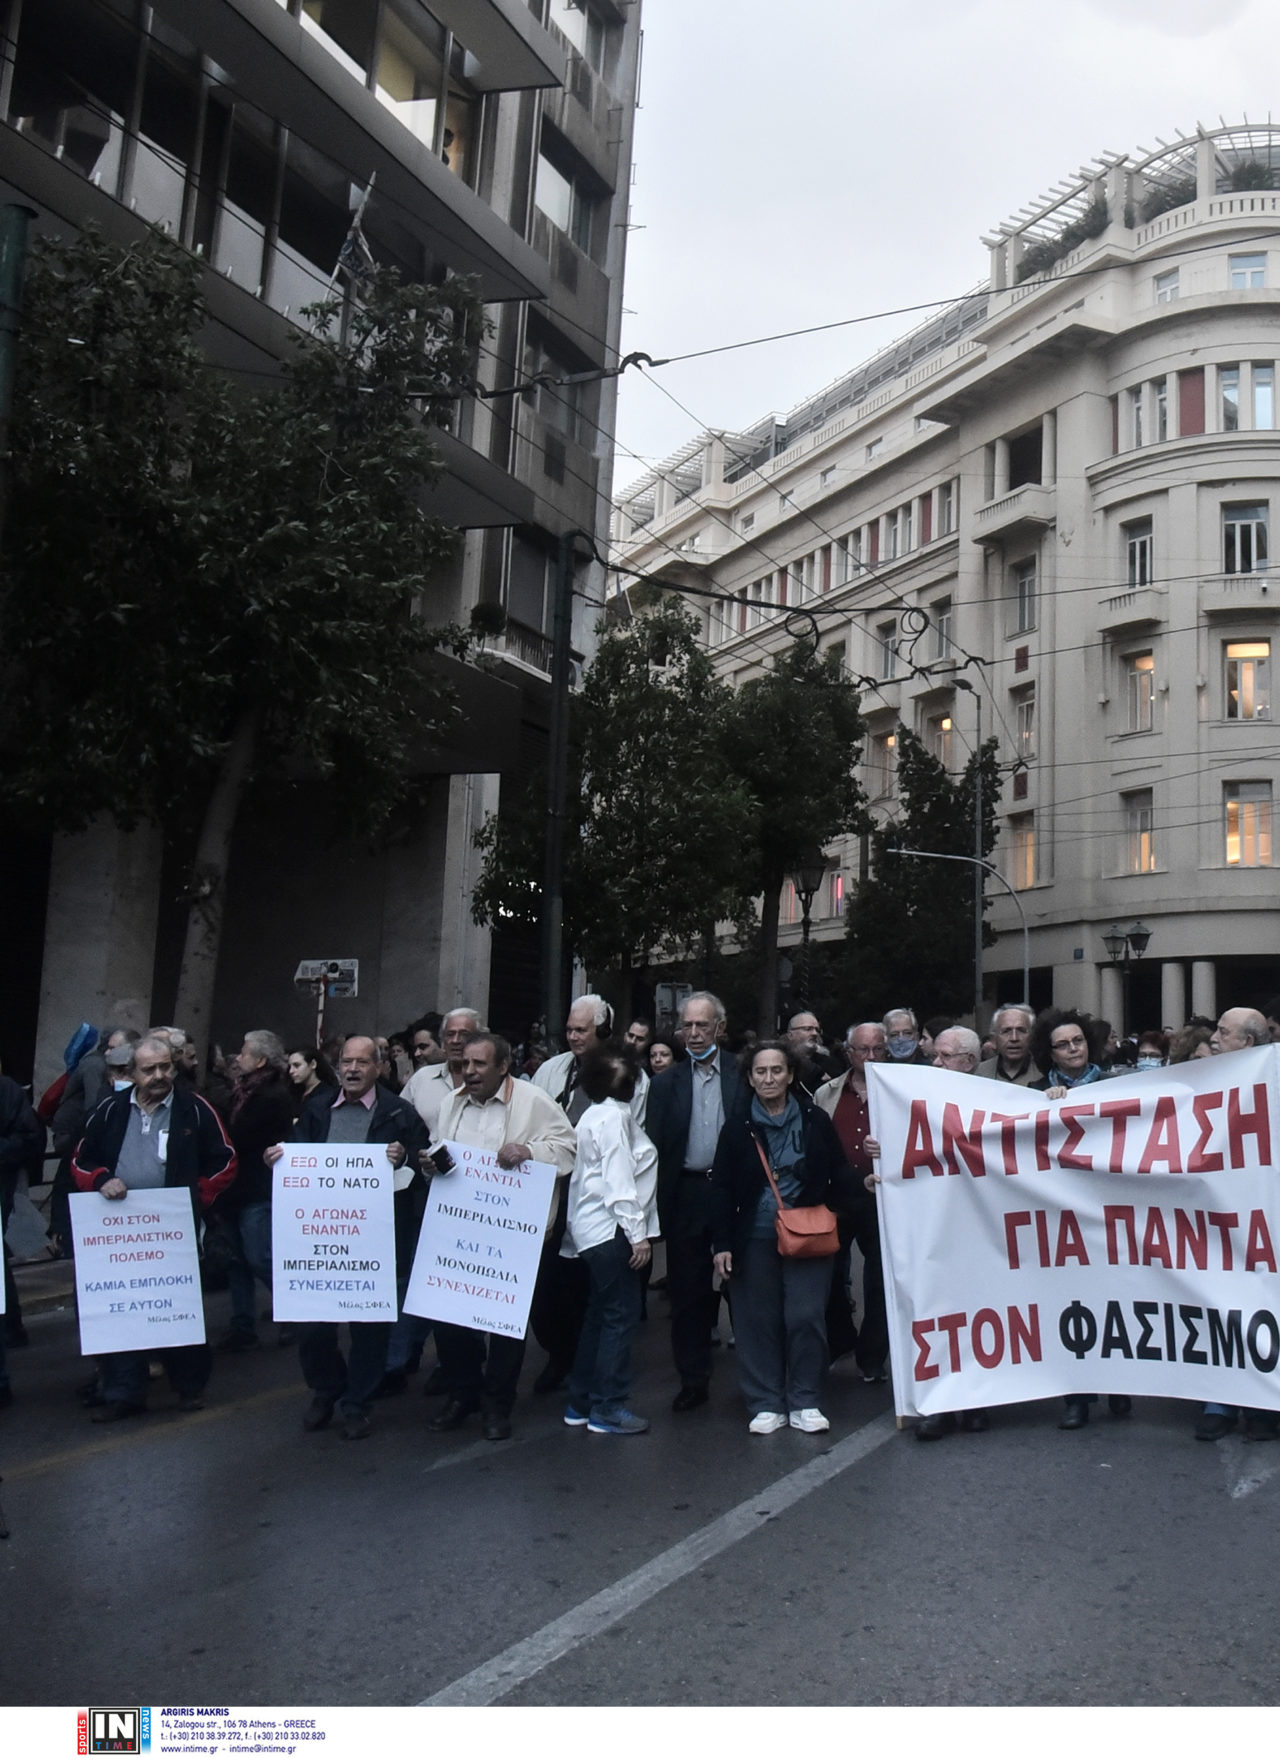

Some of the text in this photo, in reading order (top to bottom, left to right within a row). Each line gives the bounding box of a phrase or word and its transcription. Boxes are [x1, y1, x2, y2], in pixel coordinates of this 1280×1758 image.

[902, 1082, 1272, 1179] ΑΝΤΙΣΤΑΣΗ
[291, 1157, 374, 1168] ΕΞΩ ΟΙ ΗΠΑ
[462, 1150, 531, 1176] Ο ΑΓΑΣ
[283, 1177, 380, 1188] ΕΞΩ ΤΟ ΝΑΤΟ
[464, 1167, 522, 1189] ΕΝΑΝΤΙΑ
[474, 1190, 511, 1207] ΣΤΟΝ
[102, 1214, 160, 1227] ΟΧΙ ΣΤΟΝ
[295, 1208, 367, 1220] Ο ΑΓΩΝΑΣ
[436, 1203, 538, 1235] ΙΜΠΕΡΙΑΛΙΣΜΟ
[302, 1224, 360, 1235] ΕΝΑΝΤΙΑ
[83, 1230, 184, 1246] ΙΜΠΕΡΙΑΛΙΣΤΙΚΟ
[1004, 1204, 1278, 1273] ΓΙΑ ΠΑΝΤΑ
[110, 1250, 164, 1263] ΠΟΛΕΜΟ
[314, 1244, 349, 1255] ΣΤΟΝ
[456, 1238, 503, 1259] ΚΑΙ ΤΑ
[283, 1260, 380, 1271] ΙΜΠΕΡΙΑΛΙΣΜΟ
[435, 1255, 519, 1284] ΜΟΝΟΠΩΛΙΑ
[84, 1275, 193, 1292] ΚΑΜΙΑ ΕΜΠΛΟΚΗ
[289, 1280, 375, 1291] ΣΥΝΕΧΙΖΕΤΑΙ
[426, 1275, 517, 1304] ΣΥΝΕΧΙΖΕΤΑΙ
[109, 1299, 172, 1313] ΣΕ ΑΥΤΟΝ
[366, 1301, 390, 1309] ΣΦΕΑ
[912, 1299, 1280, 1382] ΣΤΟΝ ΦΑΣΙΣΜΟ
